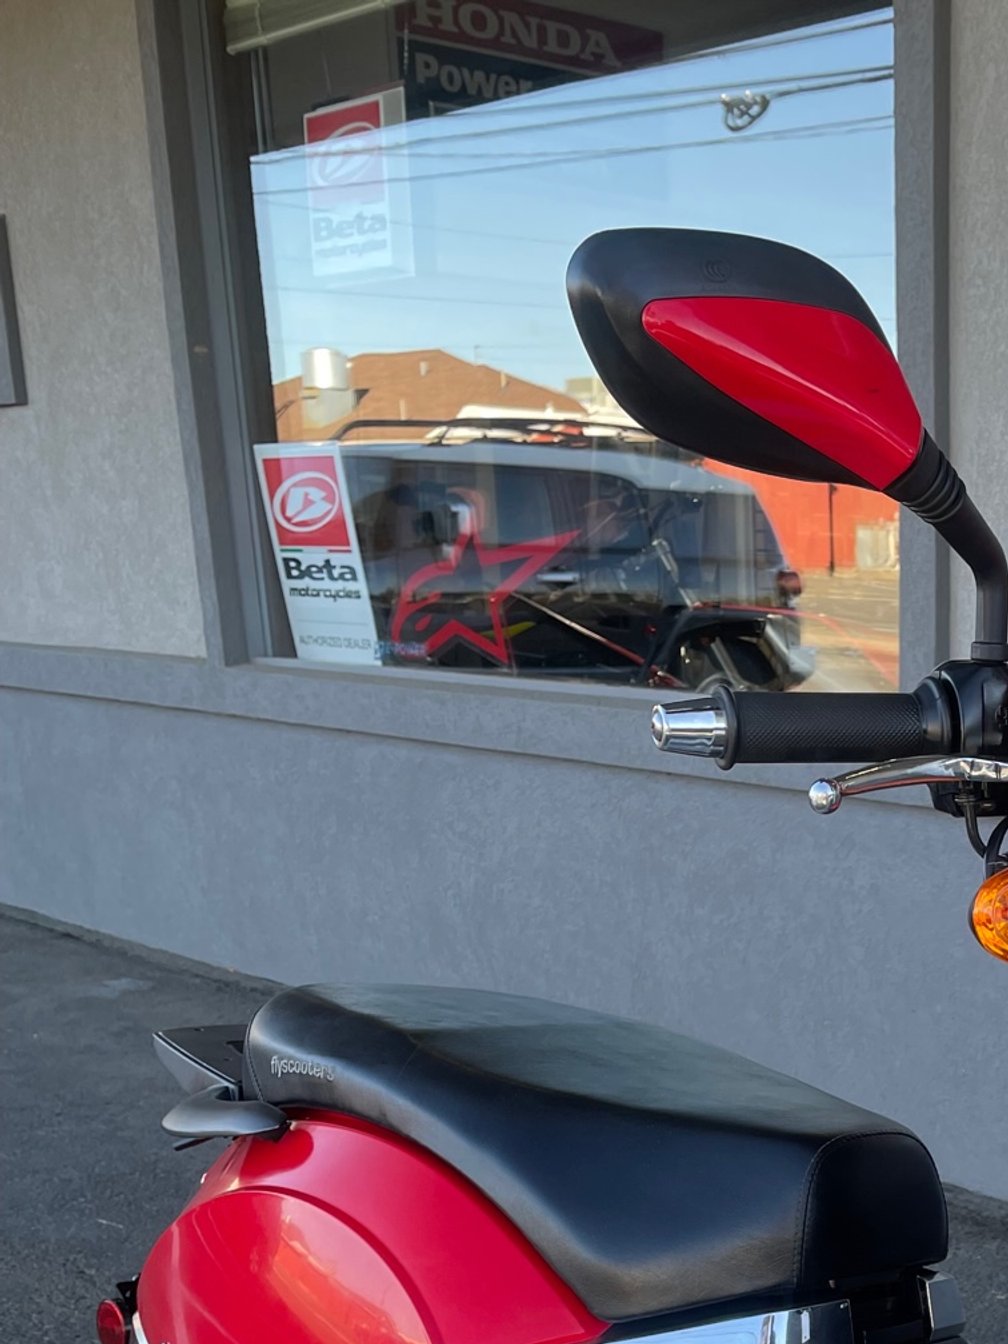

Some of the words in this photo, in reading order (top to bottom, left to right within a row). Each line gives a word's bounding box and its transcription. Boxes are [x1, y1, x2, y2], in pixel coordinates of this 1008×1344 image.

[413, 0, 622, 68] HONDA
[414, 52, 534, 99] Power
[313, 211, 388, 242] Beta
[282, 557, 358, 582] Beta
[289, 585, 361, 602] motorcycles
[271, 1055, 334, 1081] flyscooters
